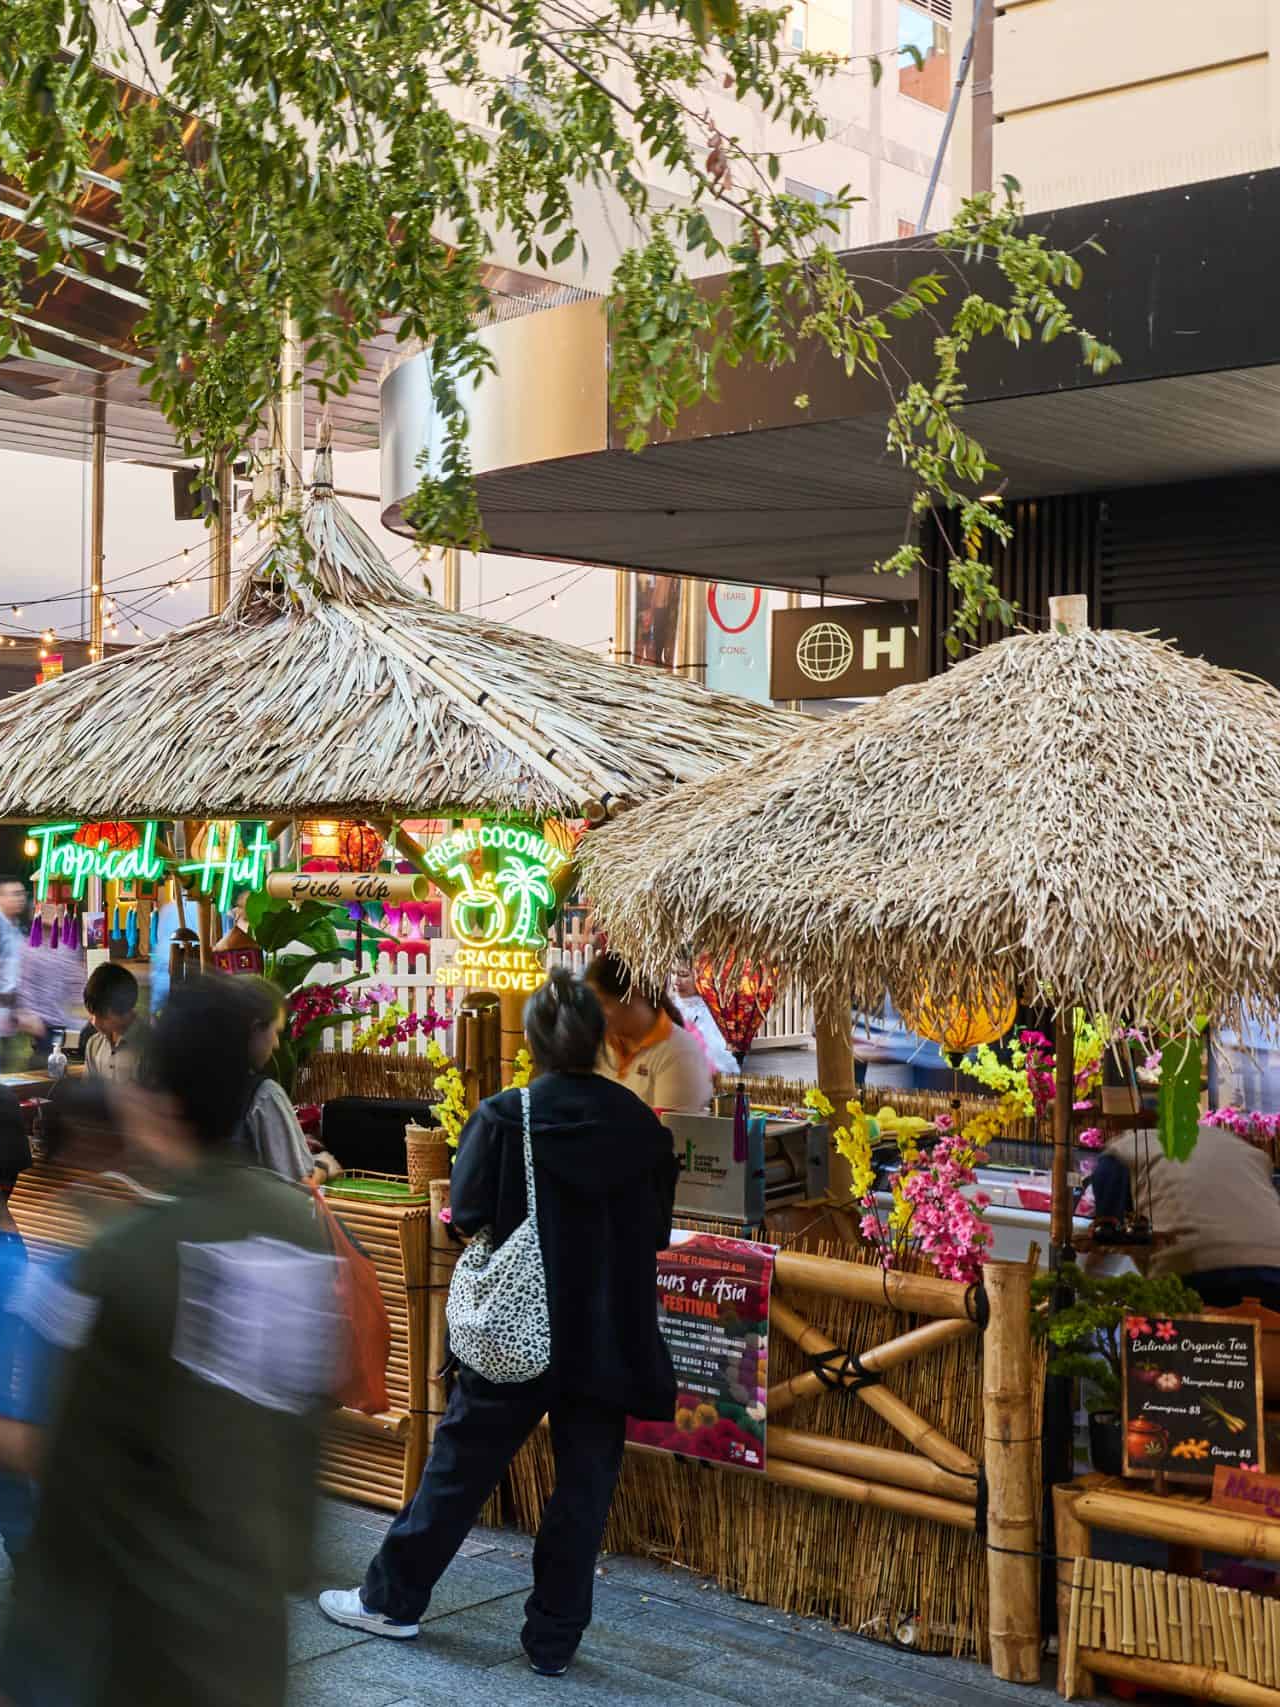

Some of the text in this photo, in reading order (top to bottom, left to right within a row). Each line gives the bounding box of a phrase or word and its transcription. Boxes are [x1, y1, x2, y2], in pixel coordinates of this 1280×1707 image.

[863, 625, 920, 670] H
[423, 825, 567, 872] FRESH COCONUT
[27, 820, 278, 913] Tropical Hut
[291, 874, 391, 899] Pick Up
[454, 951, 536, 969] CRACK IT.
[435, 969, 462, 985] SIP
[488, 972, 535, 991] LOVE
[656, 1265, 747, 1305] ours of Asia
[663, 1294, 720, 1320] FESTIVAL
[1131, 1337, 1248, 1353] Balinese Organic Tea
[681, 1357, 702, 1367] MARCH
[1226, 1379, 1245, 1390] $10
